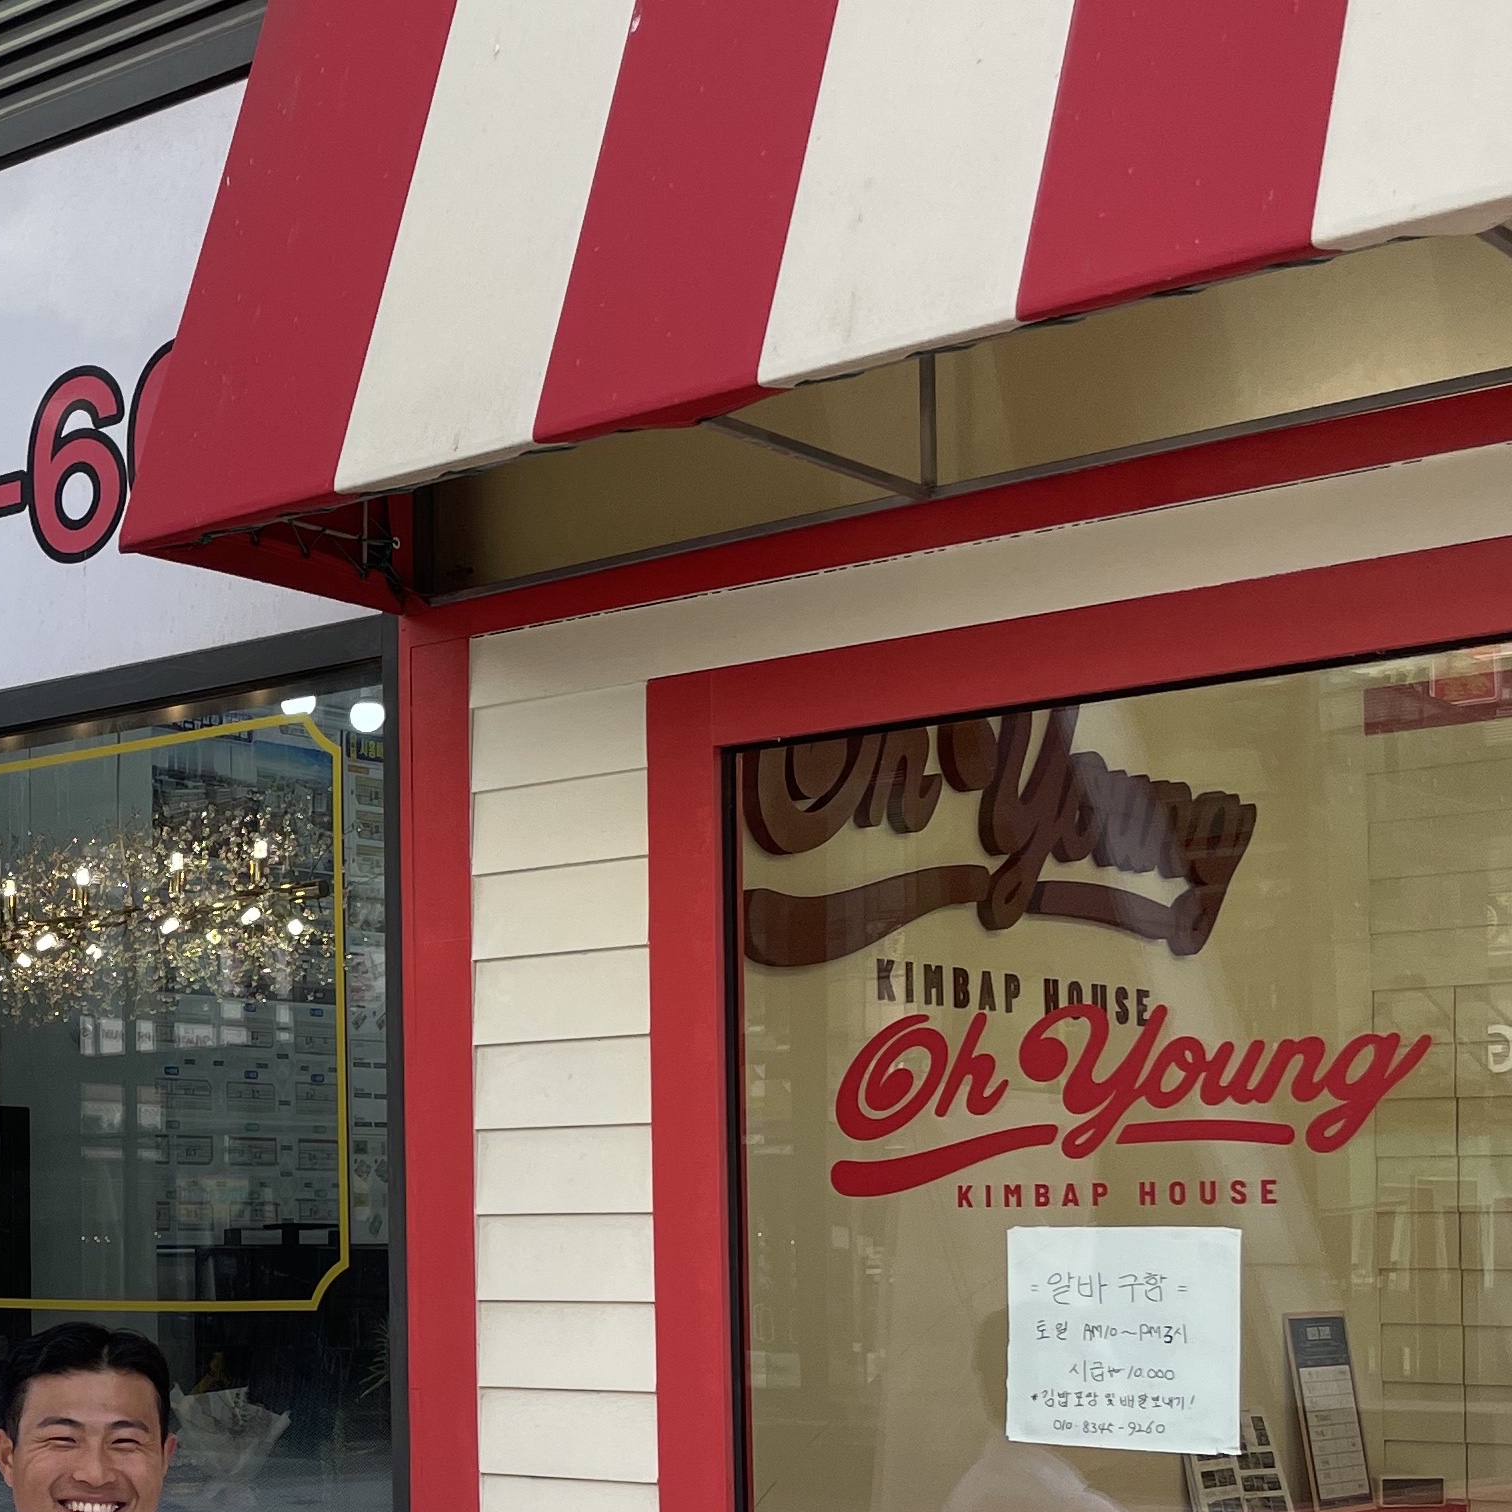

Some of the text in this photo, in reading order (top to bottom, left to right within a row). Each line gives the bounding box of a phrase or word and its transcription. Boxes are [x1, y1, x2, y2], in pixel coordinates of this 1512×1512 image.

[875, 957, 1152, 1028] KIMBAP HOUSE
[835, 1003, 1432, 1160] Oh Young
[957, 1179, 1279, 1208] KIMBAP HOUSE
[1047, 1271, 1168, 1305] 알바 구함
